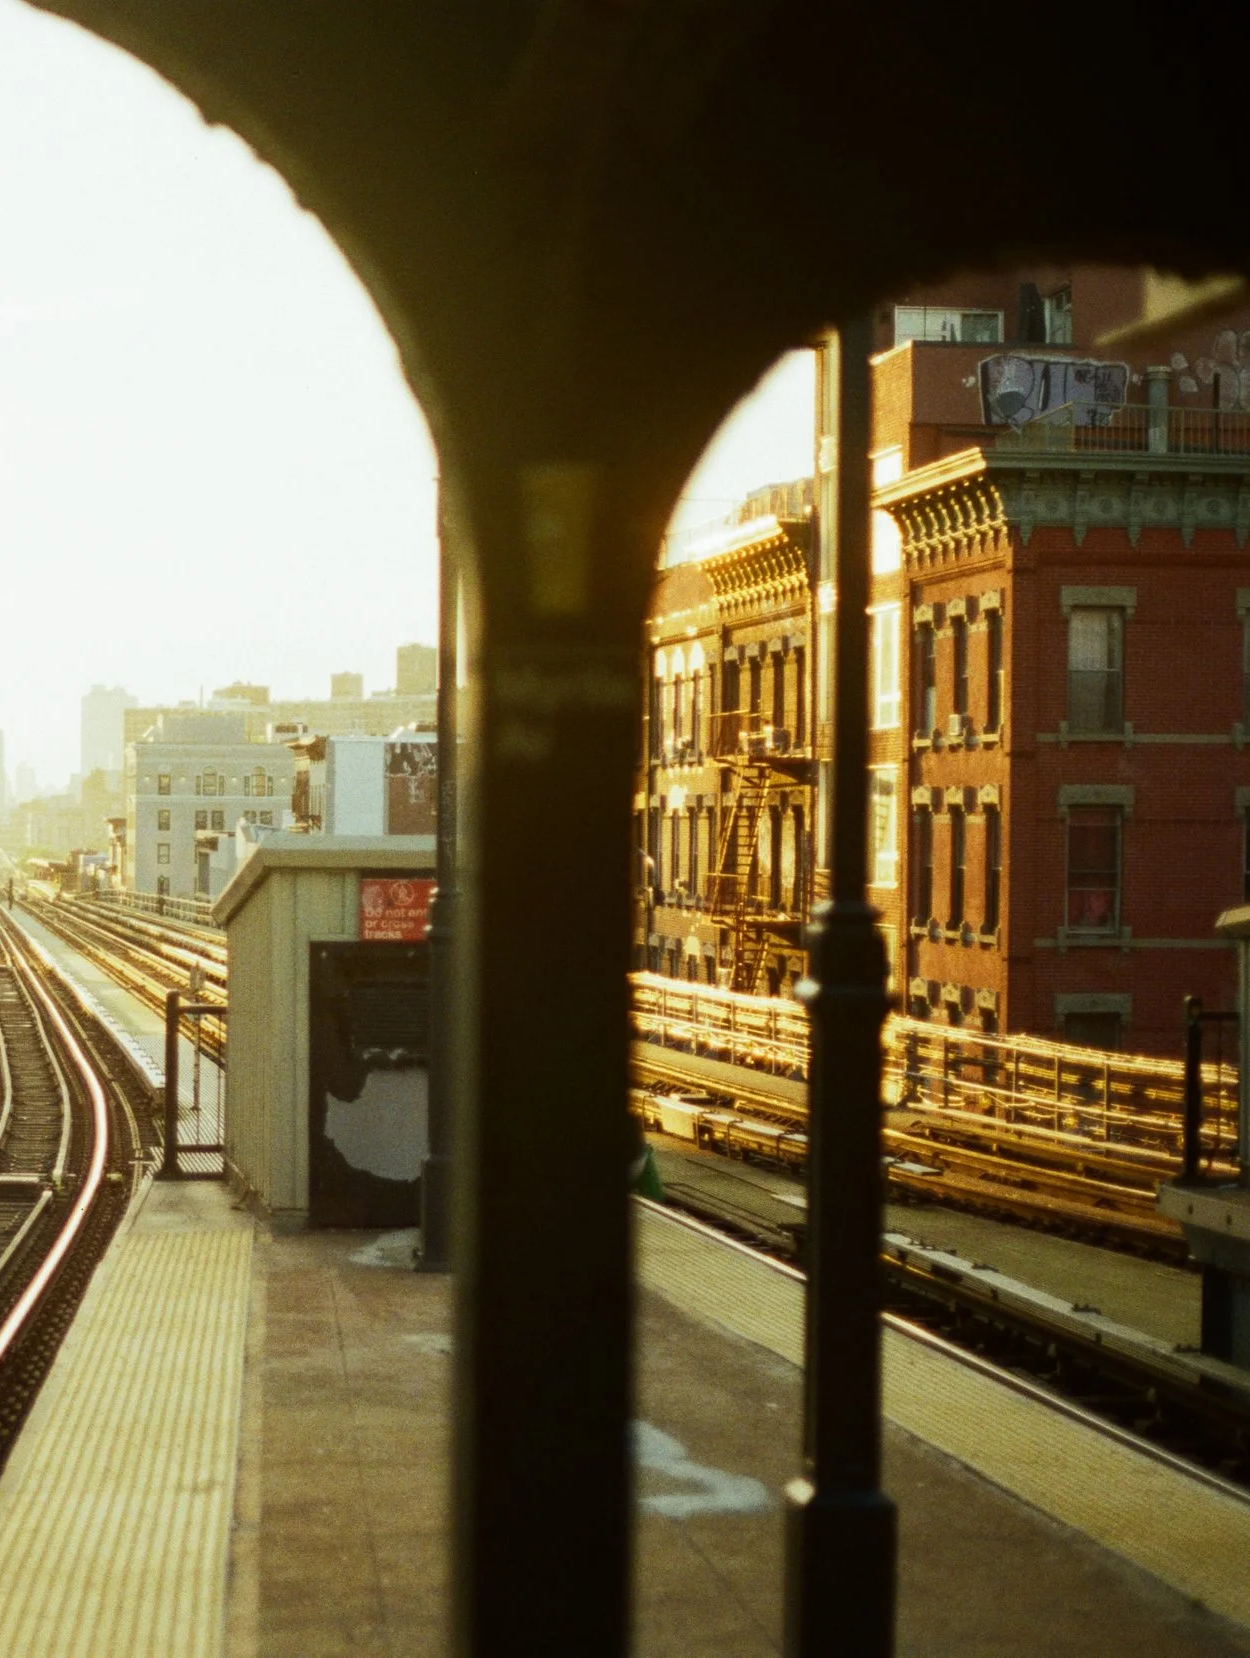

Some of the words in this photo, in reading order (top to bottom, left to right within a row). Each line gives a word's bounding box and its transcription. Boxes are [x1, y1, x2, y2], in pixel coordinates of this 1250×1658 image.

[385, 908, 406, 917] not
[364, 920, 378, 928] or
[364, 929, 403, 939] tracks
